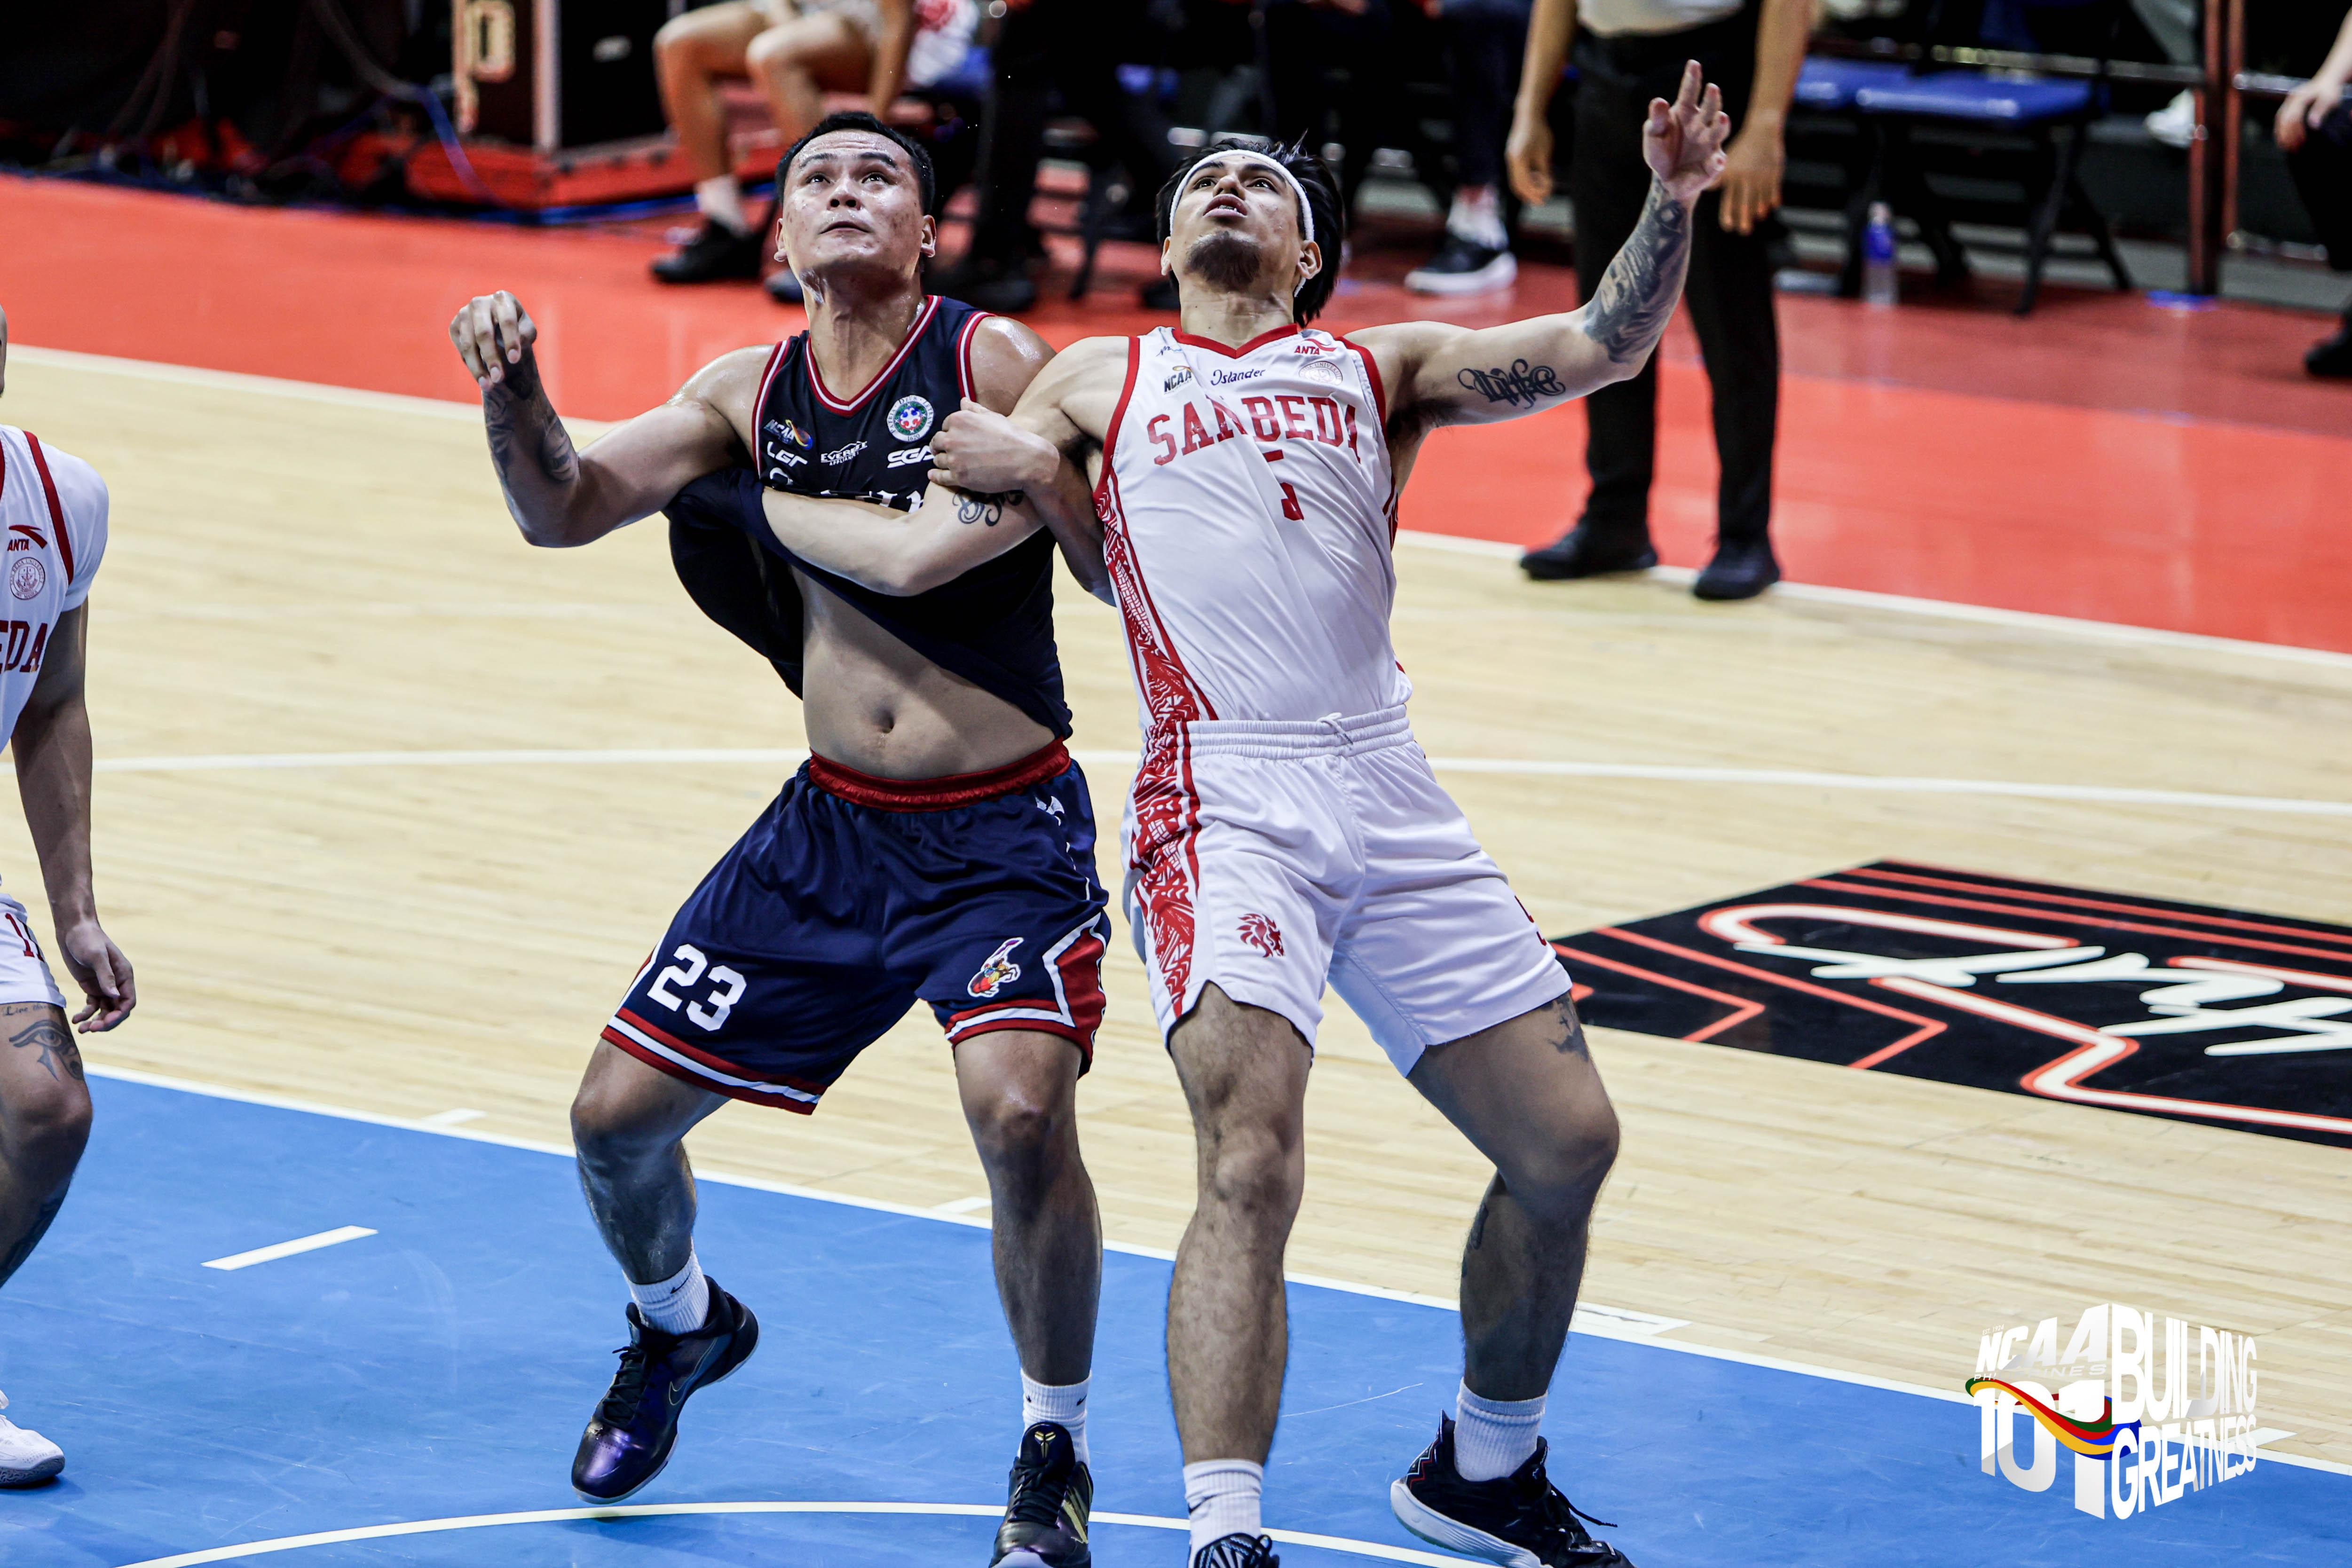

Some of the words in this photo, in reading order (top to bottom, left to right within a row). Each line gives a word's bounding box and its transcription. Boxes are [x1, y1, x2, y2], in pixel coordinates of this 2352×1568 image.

[1294, 346, 1319, 355] ANTA
[1164, 370, 1192, 393] NCAA
[7, 539, 29, 551] ANTA
[647, 944, 747, 1032] 23
